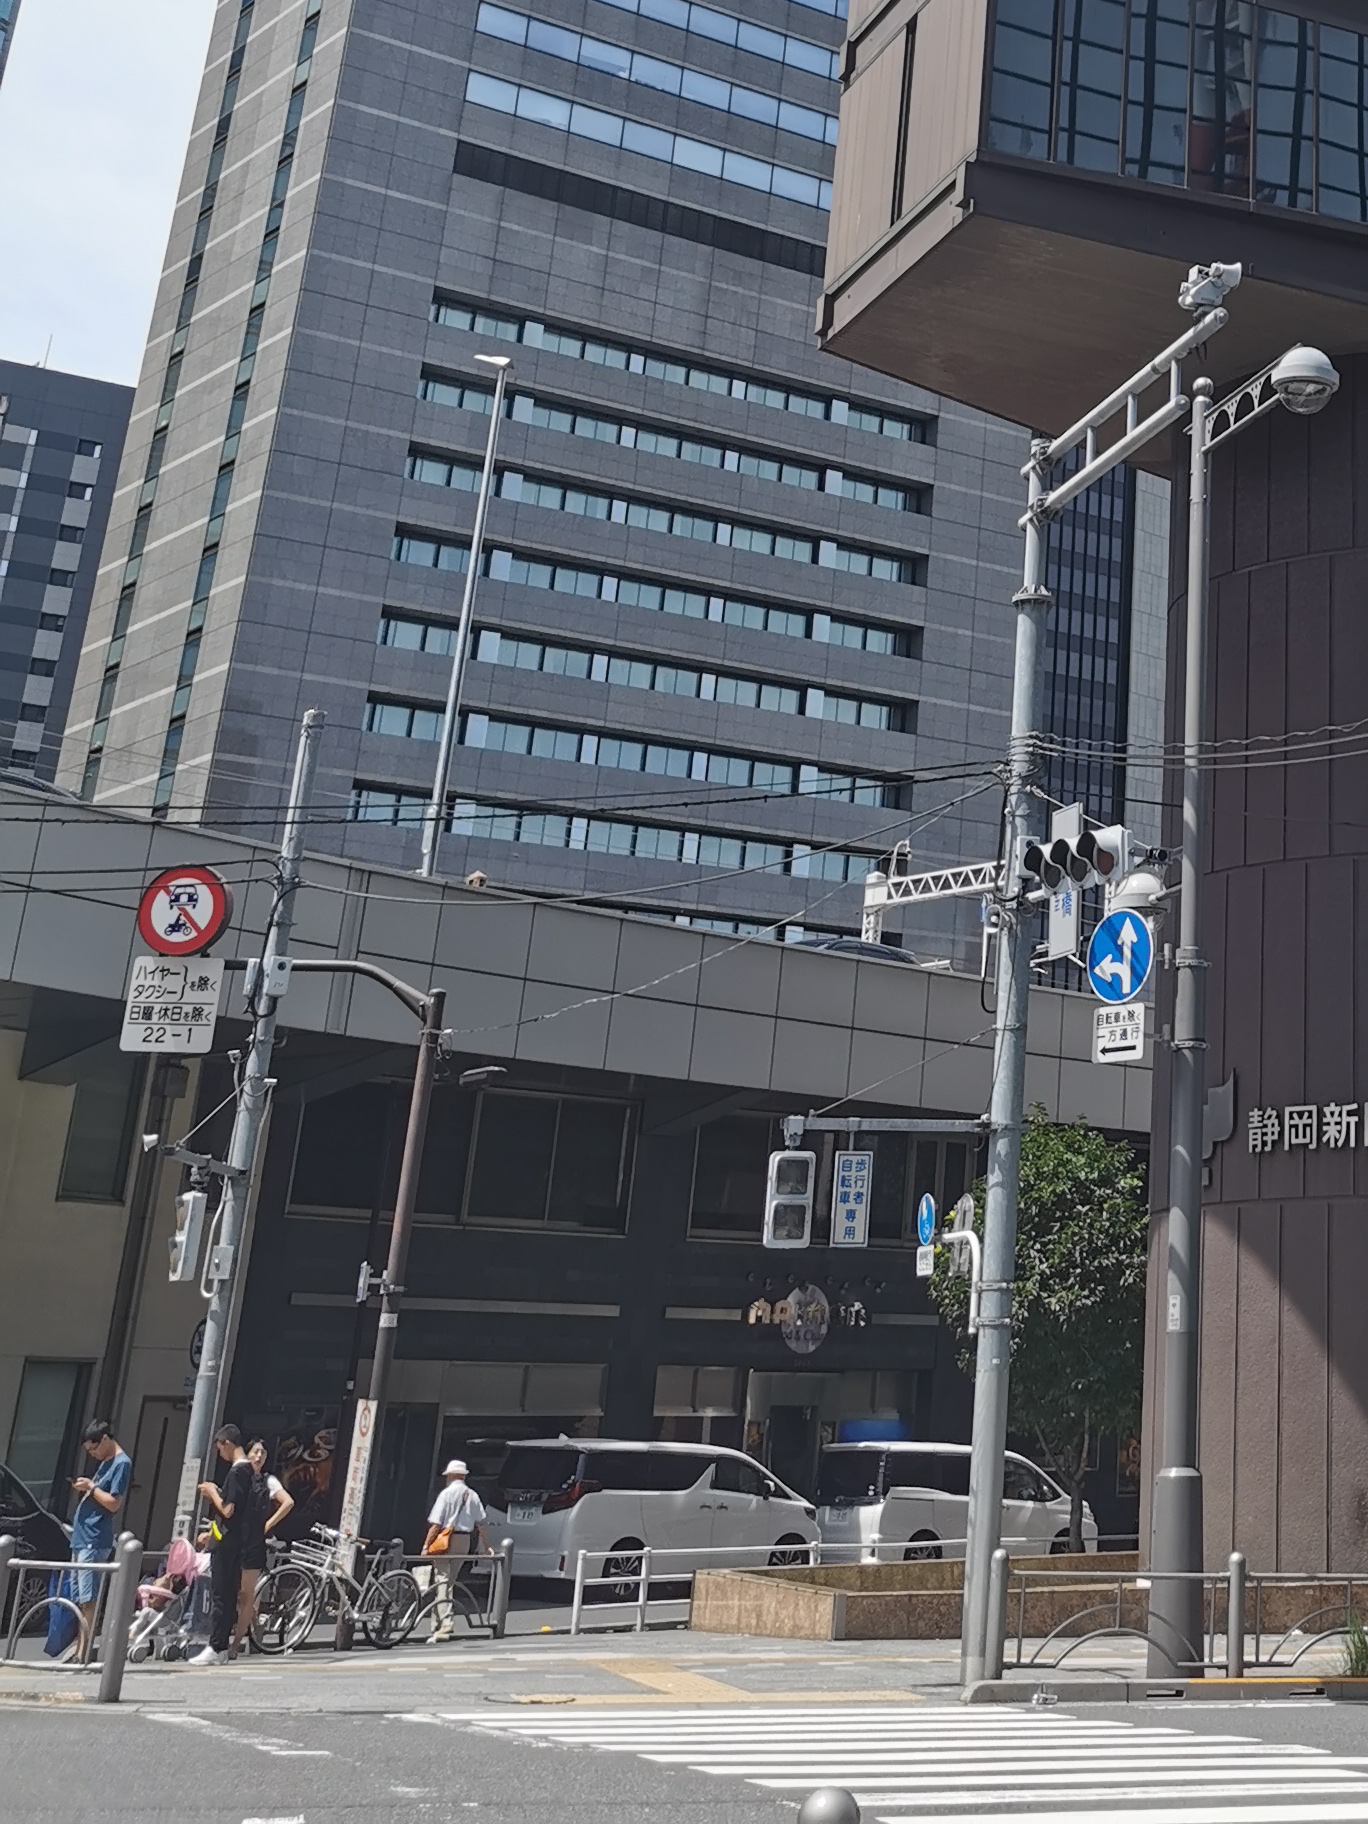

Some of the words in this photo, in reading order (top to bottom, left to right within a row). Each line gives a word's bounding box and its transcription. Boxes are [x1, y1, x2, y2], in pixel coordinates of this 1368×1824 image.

[135, 964, 182, 982] ハイヤー
[132, 984, 178, 1001] タクシー
[188, 976, 218, 993] を除く
[1096, 1026, 1141, 1043] 一方通行
[839, 1158, 853, 1204] 自転車
[852, 1158, 867, 1204] 歩行者
[842, 1208, 857, 1241] 専用
